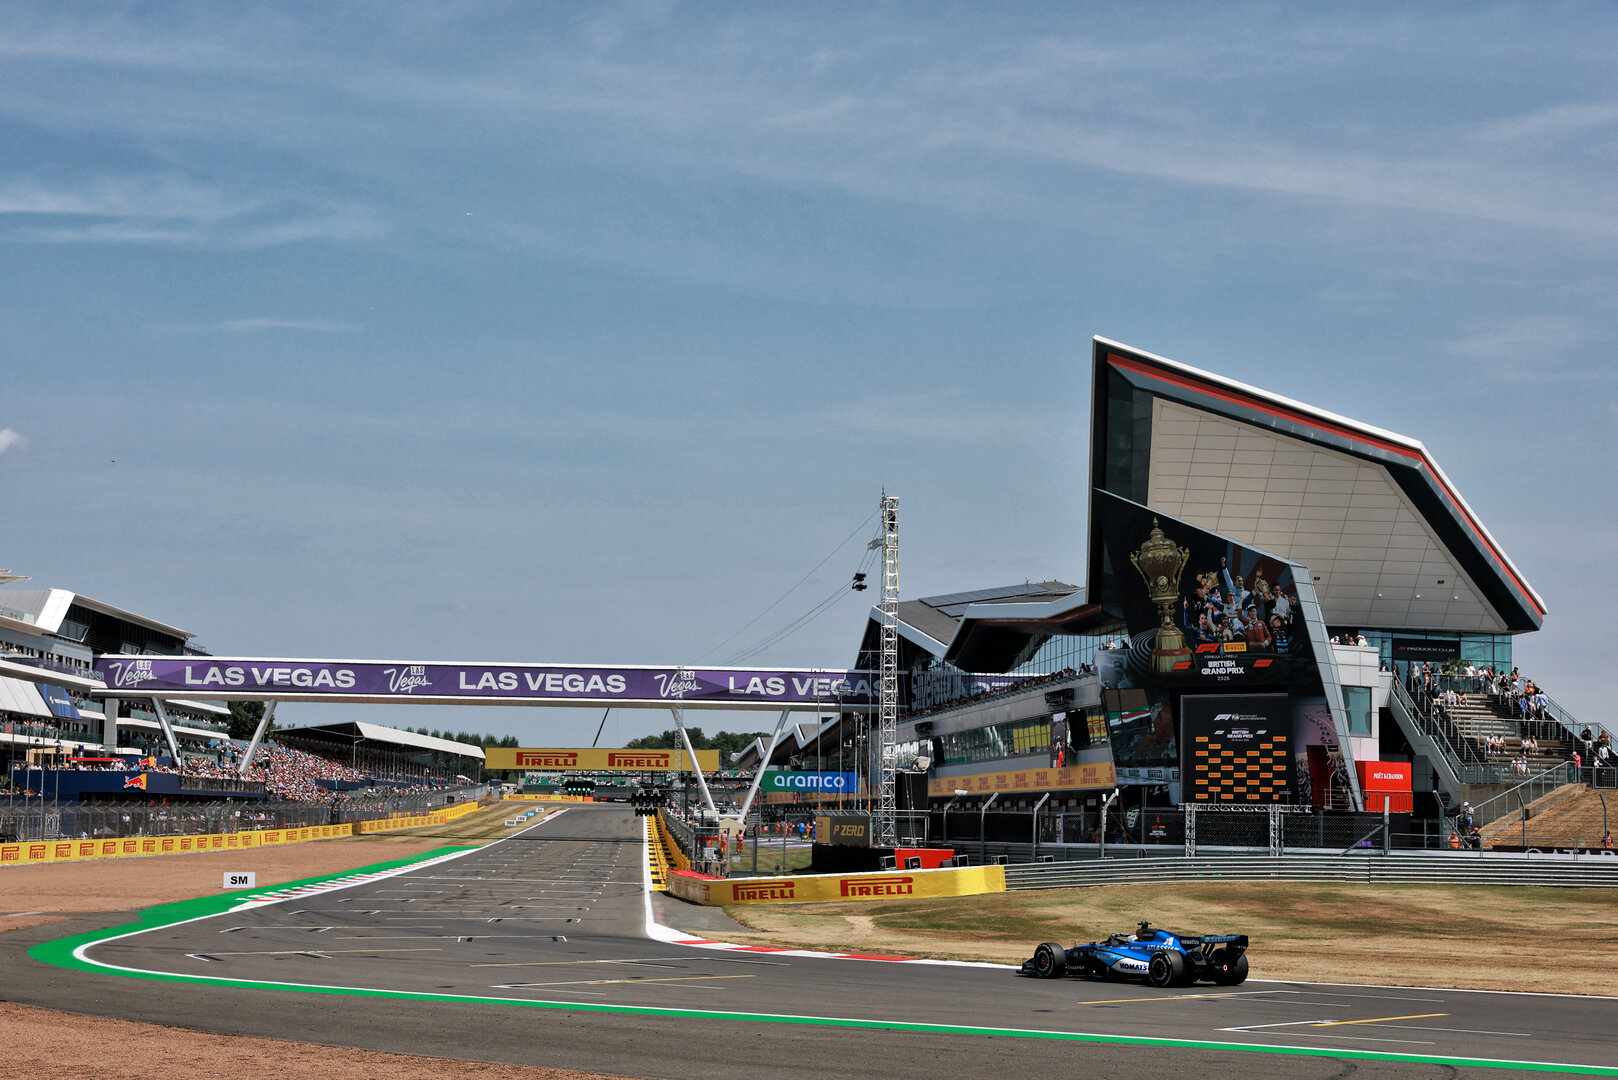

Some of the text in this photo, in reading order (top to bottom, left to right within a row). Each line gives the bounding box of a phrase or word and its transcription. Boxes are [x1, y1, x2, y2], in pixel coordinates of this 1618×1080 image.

[137, 661, 151, 669] LAS
[411, 666, 424, 675] LAS
[1208, 660, 1236, 668] BRITISH
[109, 662, 157, 687] Vegas
[185, 666, 356, 688] LAS VEGAS
[384, 667, 432, 693] Vegas
[459, 671, 626, 693] LAS VEGAS
[654, 673, 702, 697] Vegas
[728, 676, 786, 696] LAS
[516, 752, 578, 766] PIRELLI
[608, 753, 669, 767] PIRELLI
[774, 775, 844, 788] aramco
[834, 825, 839, 836] P
[840, 825, 864, 836] ZERO
[2, 846, 19, 861] PIRELLI
[230, 876, 248, 884] SM
[840, 876, 913, 897] PIRELLI
[732, 881, 795, 901] PIRELLI
